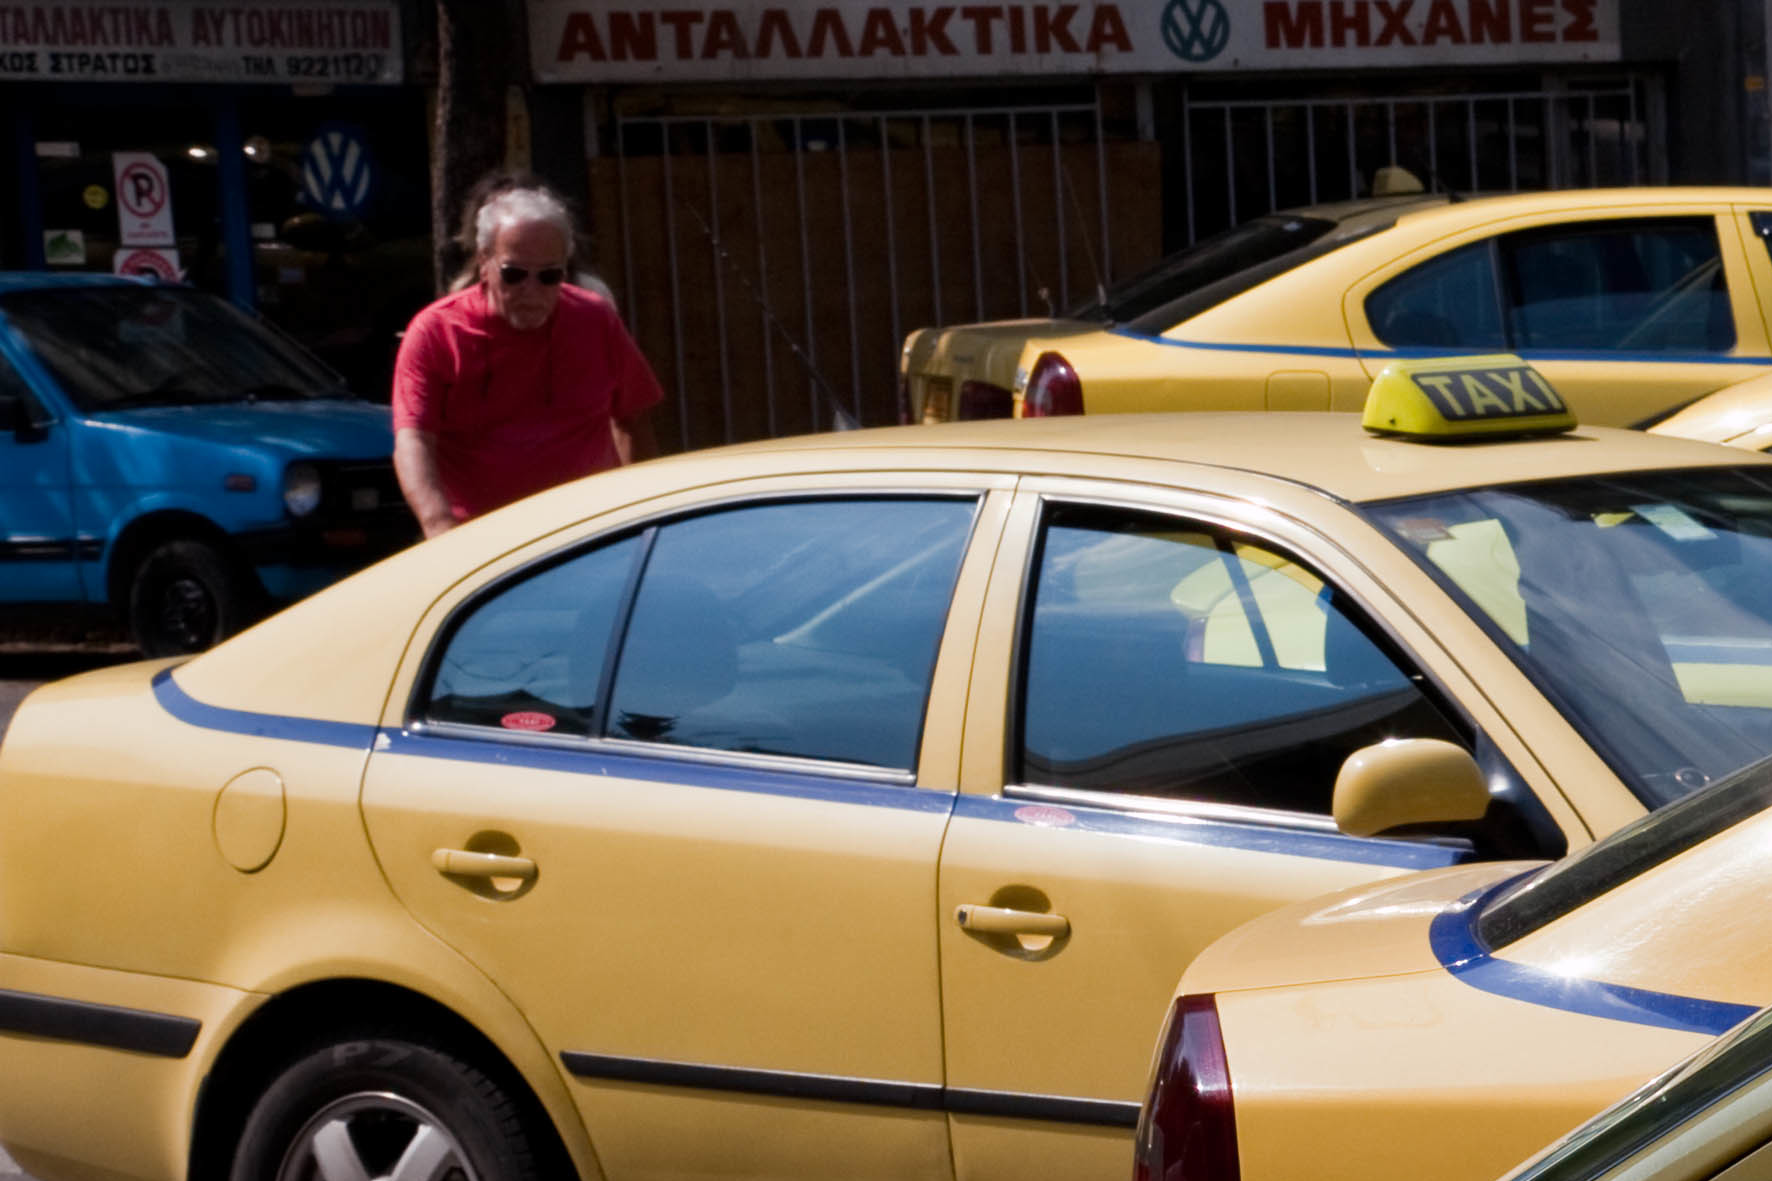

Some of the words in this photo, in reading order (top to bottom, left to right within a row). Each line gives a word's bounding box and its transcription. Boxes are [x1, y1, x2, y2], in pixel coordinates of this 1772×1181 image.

[192, 7, 390, 48] ΑΥΤΟΚΙΝΗΤΩΝ
[556, 4, 1134, 62] ΑΝΤΑΛΛΑΚΤΙΚΑ
[1264, 0, 1598, 49] ΜΗΧΑΝΕΣ
[1416, 370, 1562, 416] TAXI
